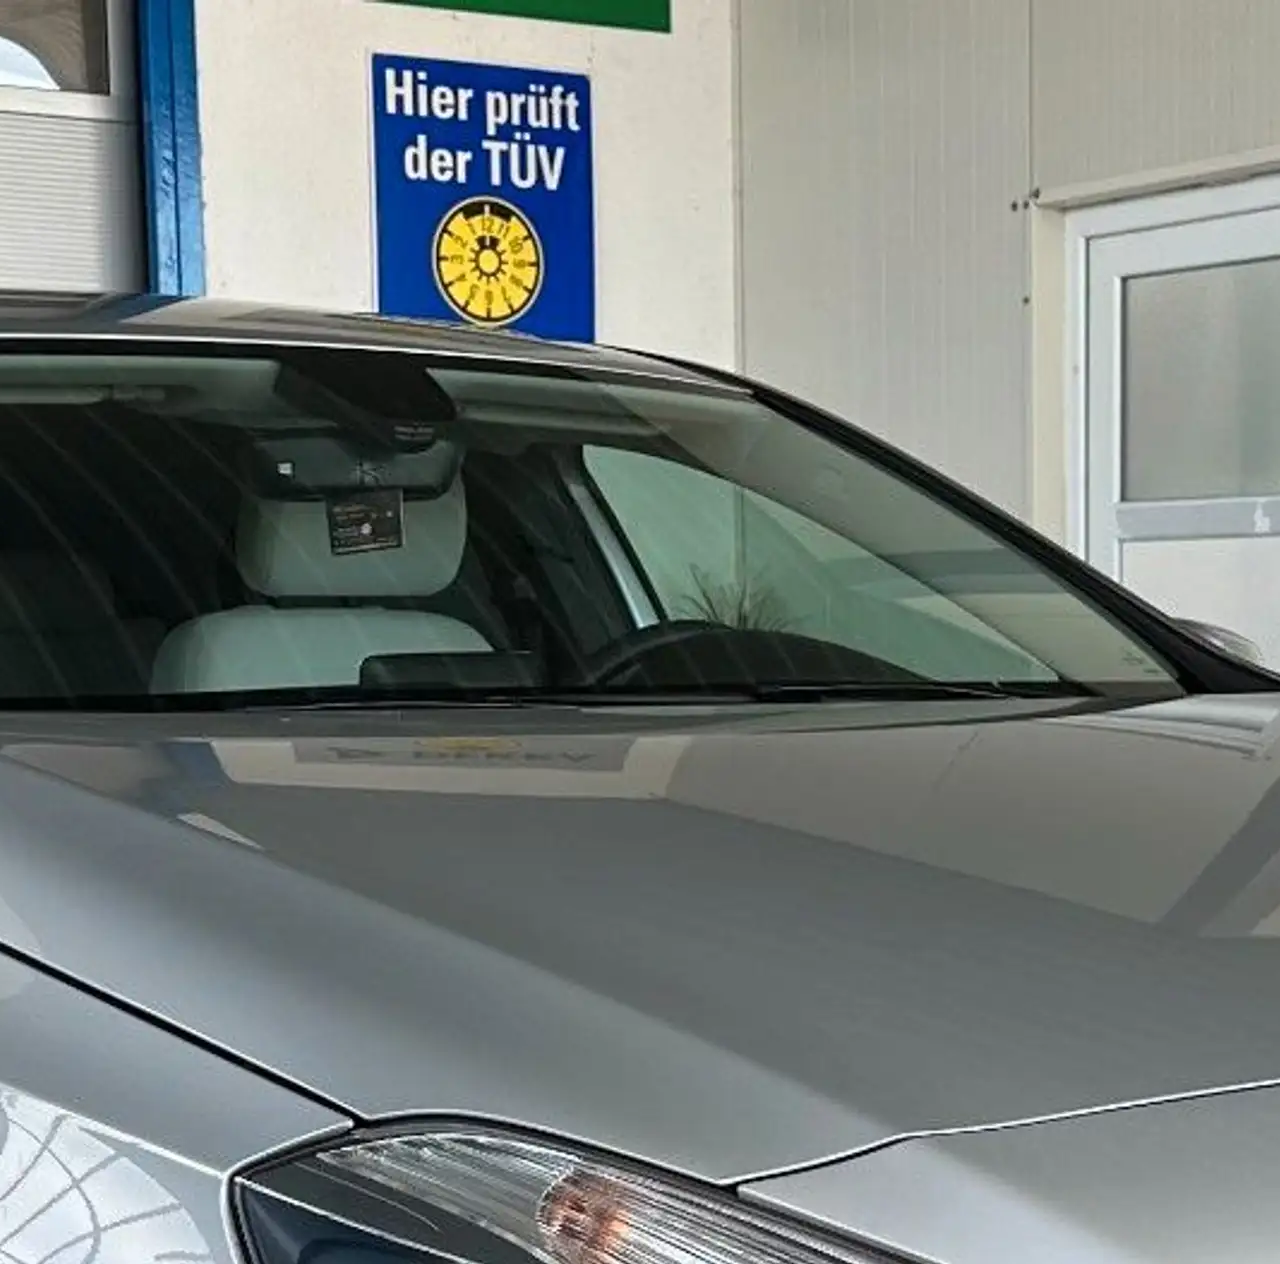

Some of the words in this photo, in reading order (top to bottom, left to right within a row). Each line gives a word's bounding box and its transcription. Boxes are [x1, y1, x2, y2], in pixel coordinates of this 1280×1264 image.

[385, 67, 474, 121] Hier
[485, 83, 581, 136] prüft
[404, 134, 473, 184] der
[481, 131, 566, 191] TÜV
